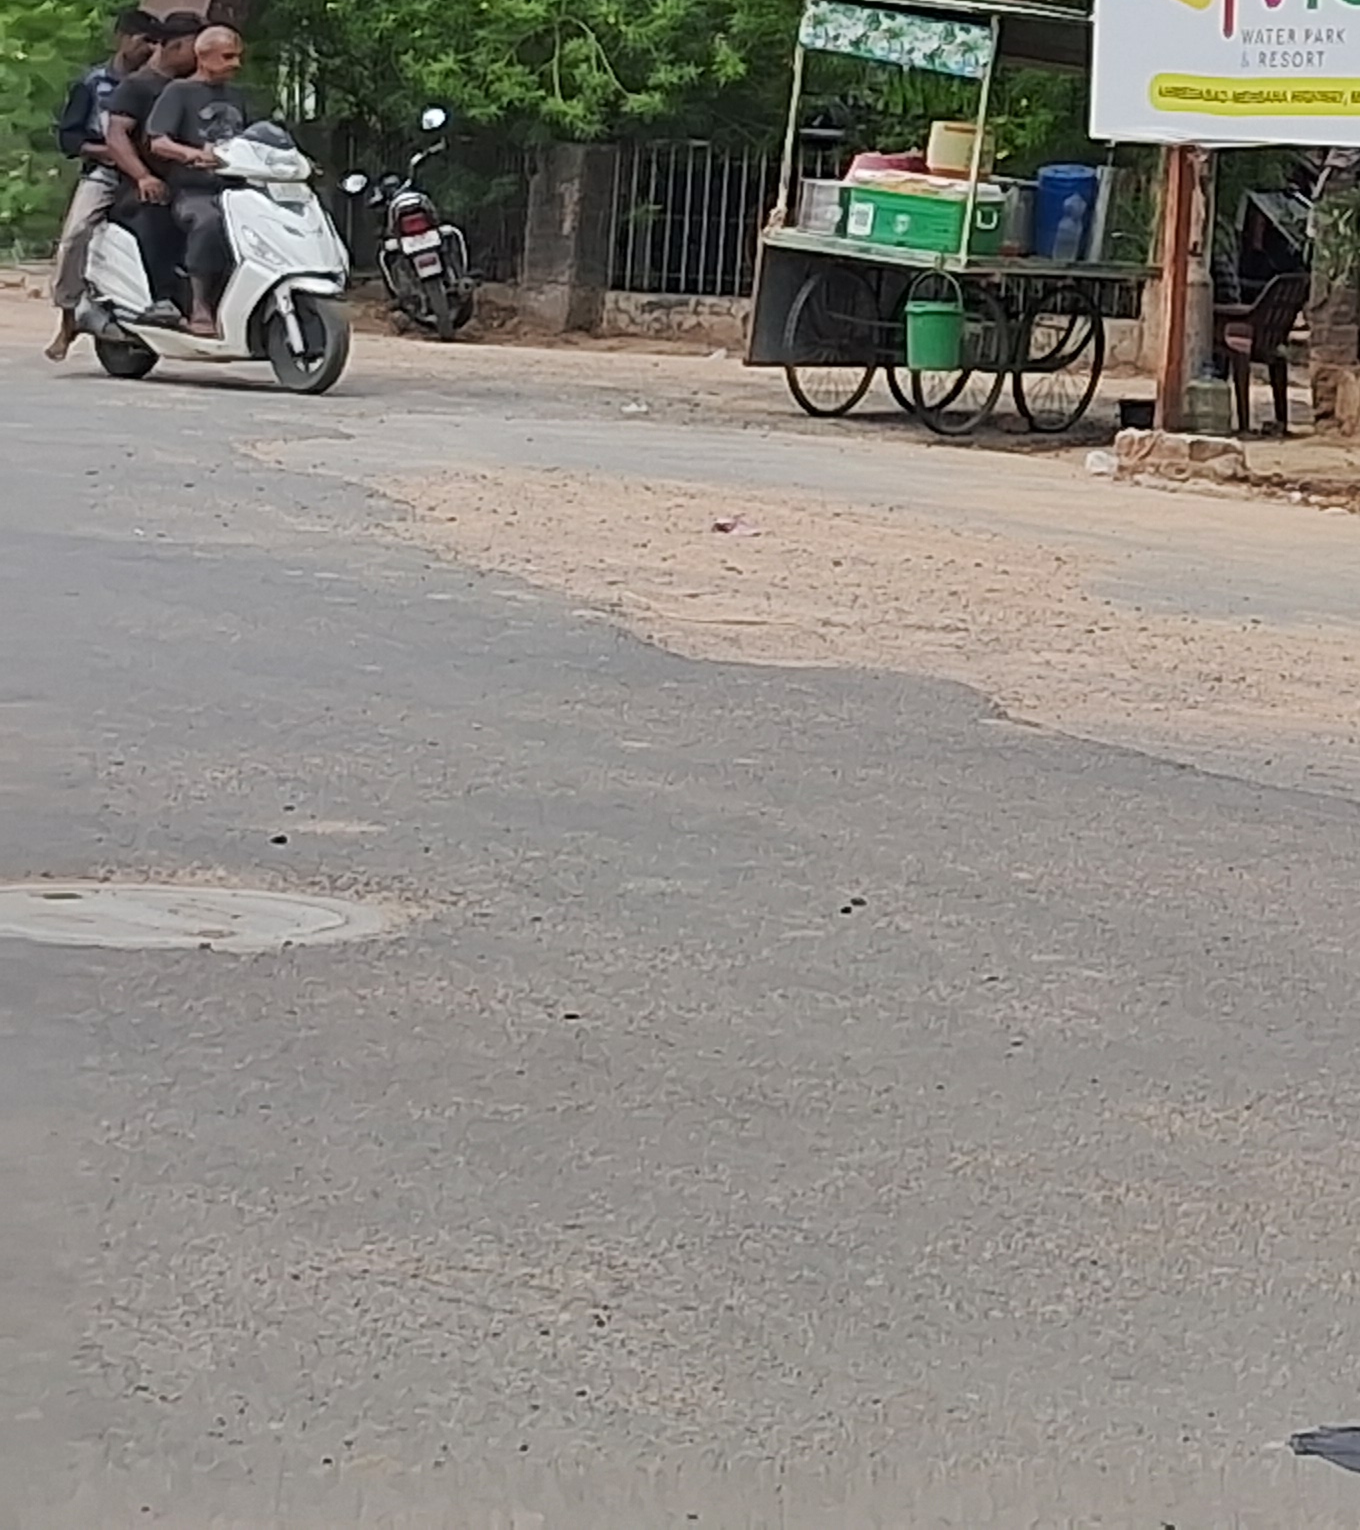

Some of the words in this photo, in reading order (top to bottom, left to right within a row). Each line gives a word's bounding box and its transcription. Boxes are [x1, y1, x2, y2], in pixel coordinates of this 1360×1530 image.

[1241, 28, 1297, 45] WATER
[1304, 29, 1346, 44] PARK
[1258, 51, 1325, 67] RESORT
